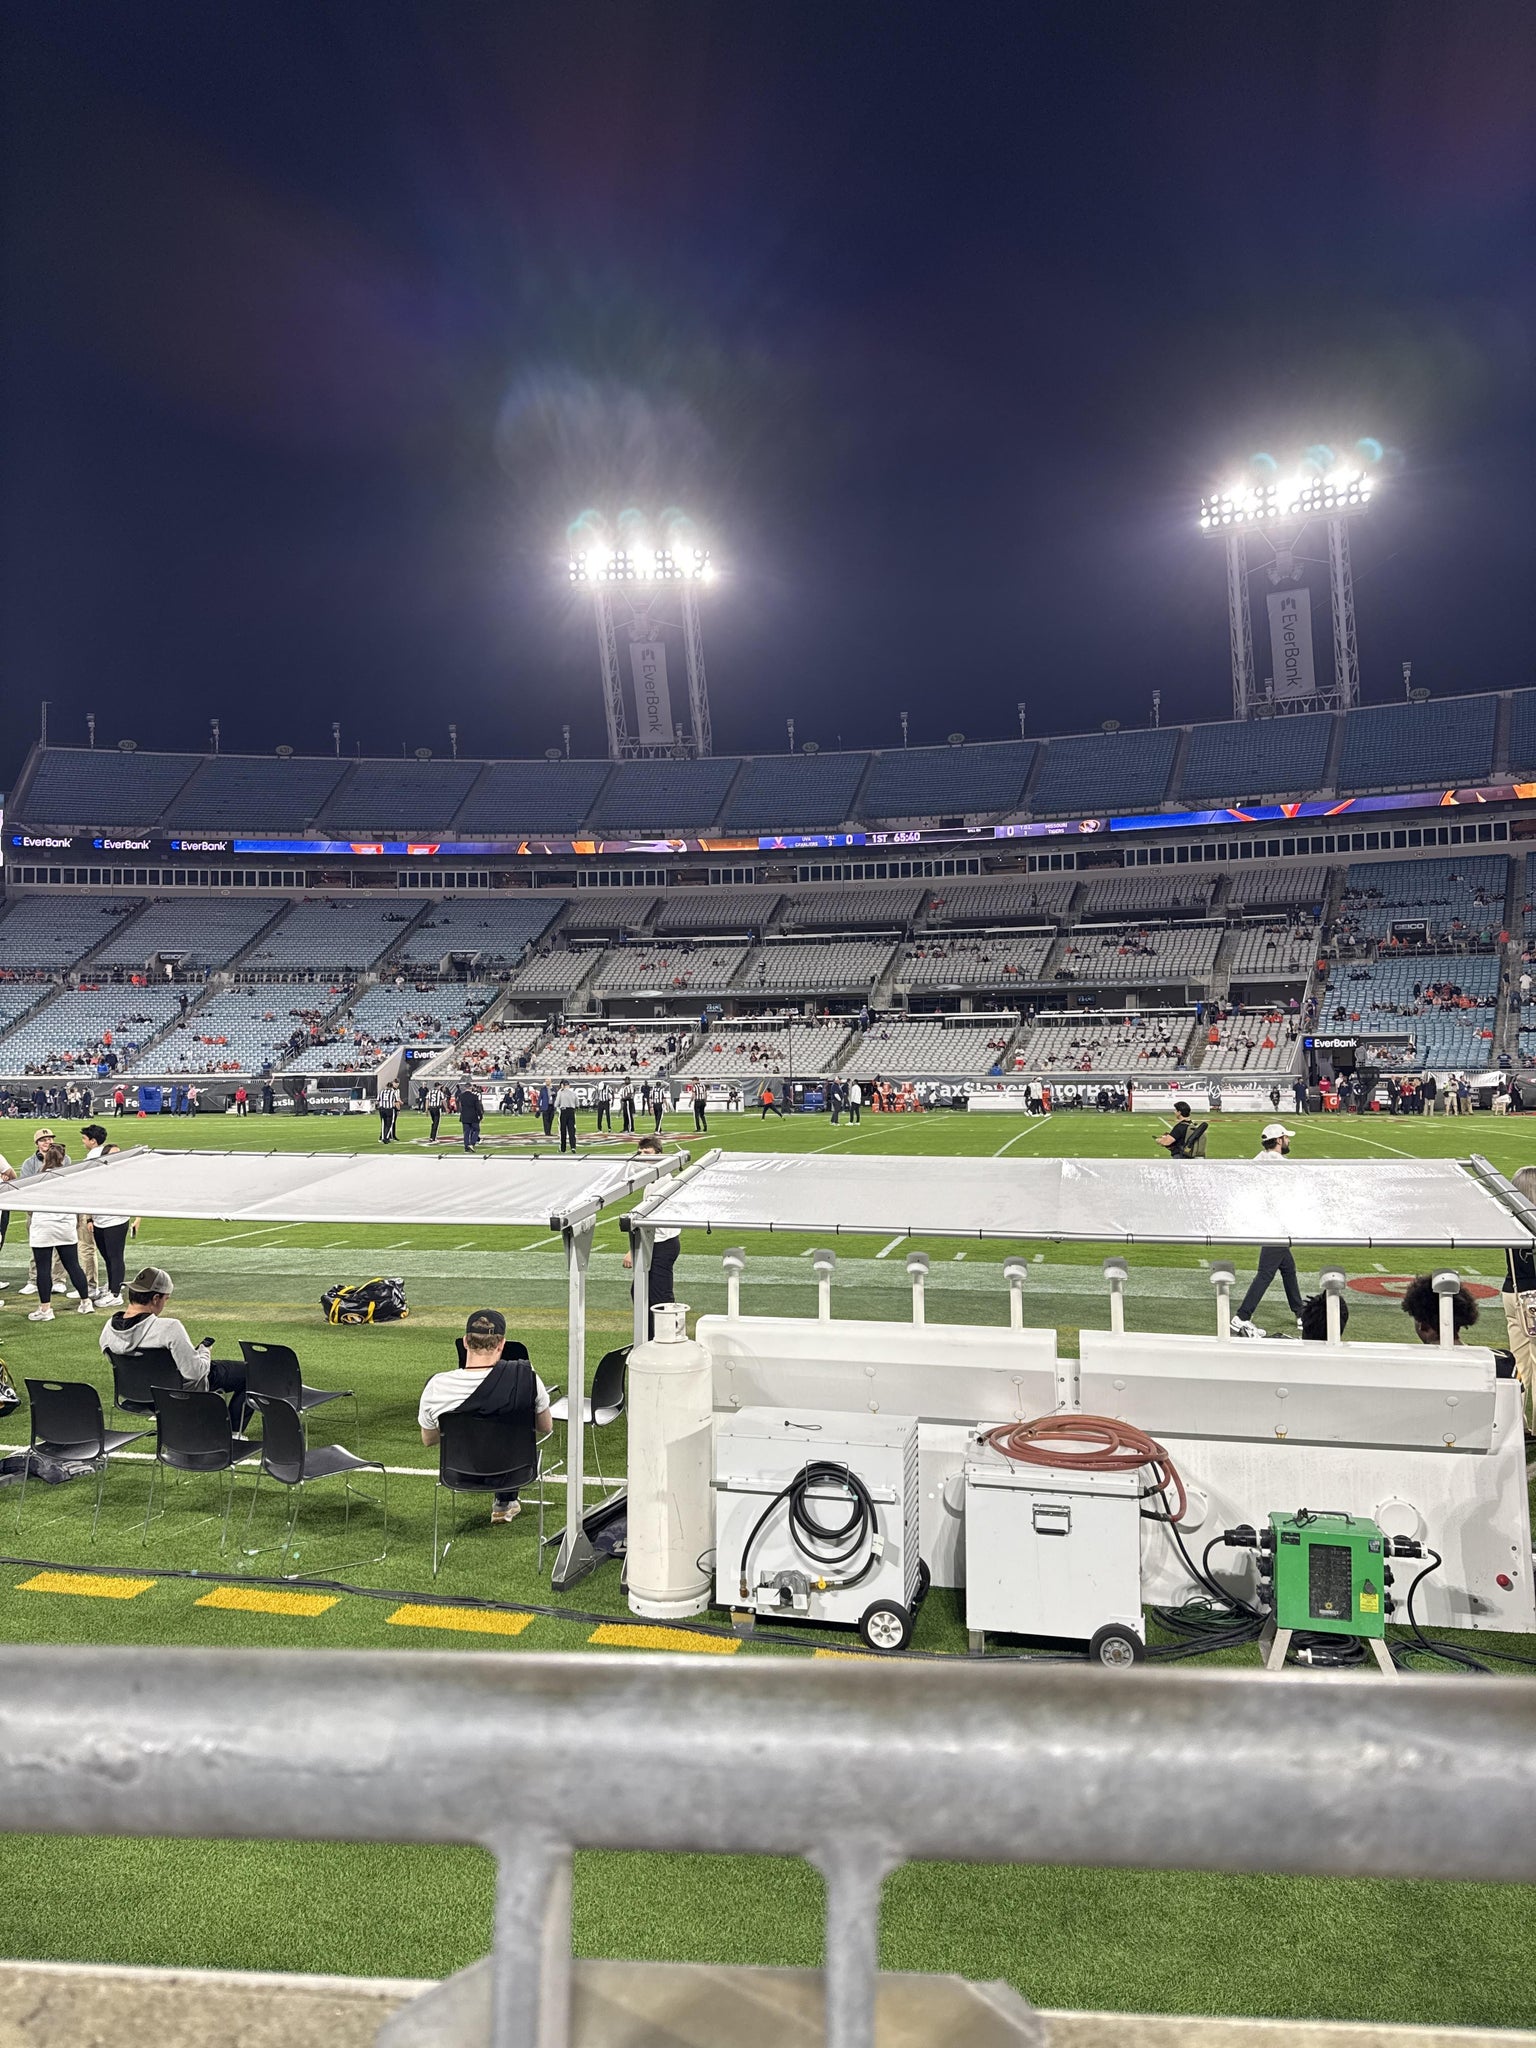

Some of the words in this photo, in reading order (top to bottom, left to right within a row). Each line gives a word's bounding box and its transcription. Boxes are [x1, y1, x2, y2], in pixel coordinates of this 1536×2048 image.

[1282, 614, 1302, 686] EverBank
[643, 664, 662, 733] EverBank
[1006, 825, 1015, 836] 0
[23, 837, 71, 848] EverBank
[845, 834, 853, 844] 0
[872, 834, 888, 843] 1ST
[893, 832, 920, 842] 65:40
[104, 839, 150, 850] EverBank
[181, 841, 226, 851] EverBank
[1067, 978, 1168, 986] INSURANCE
[1314, 1038, 1358, 1048] EverBank
[413, 1050, 442, 1059] EverBa
